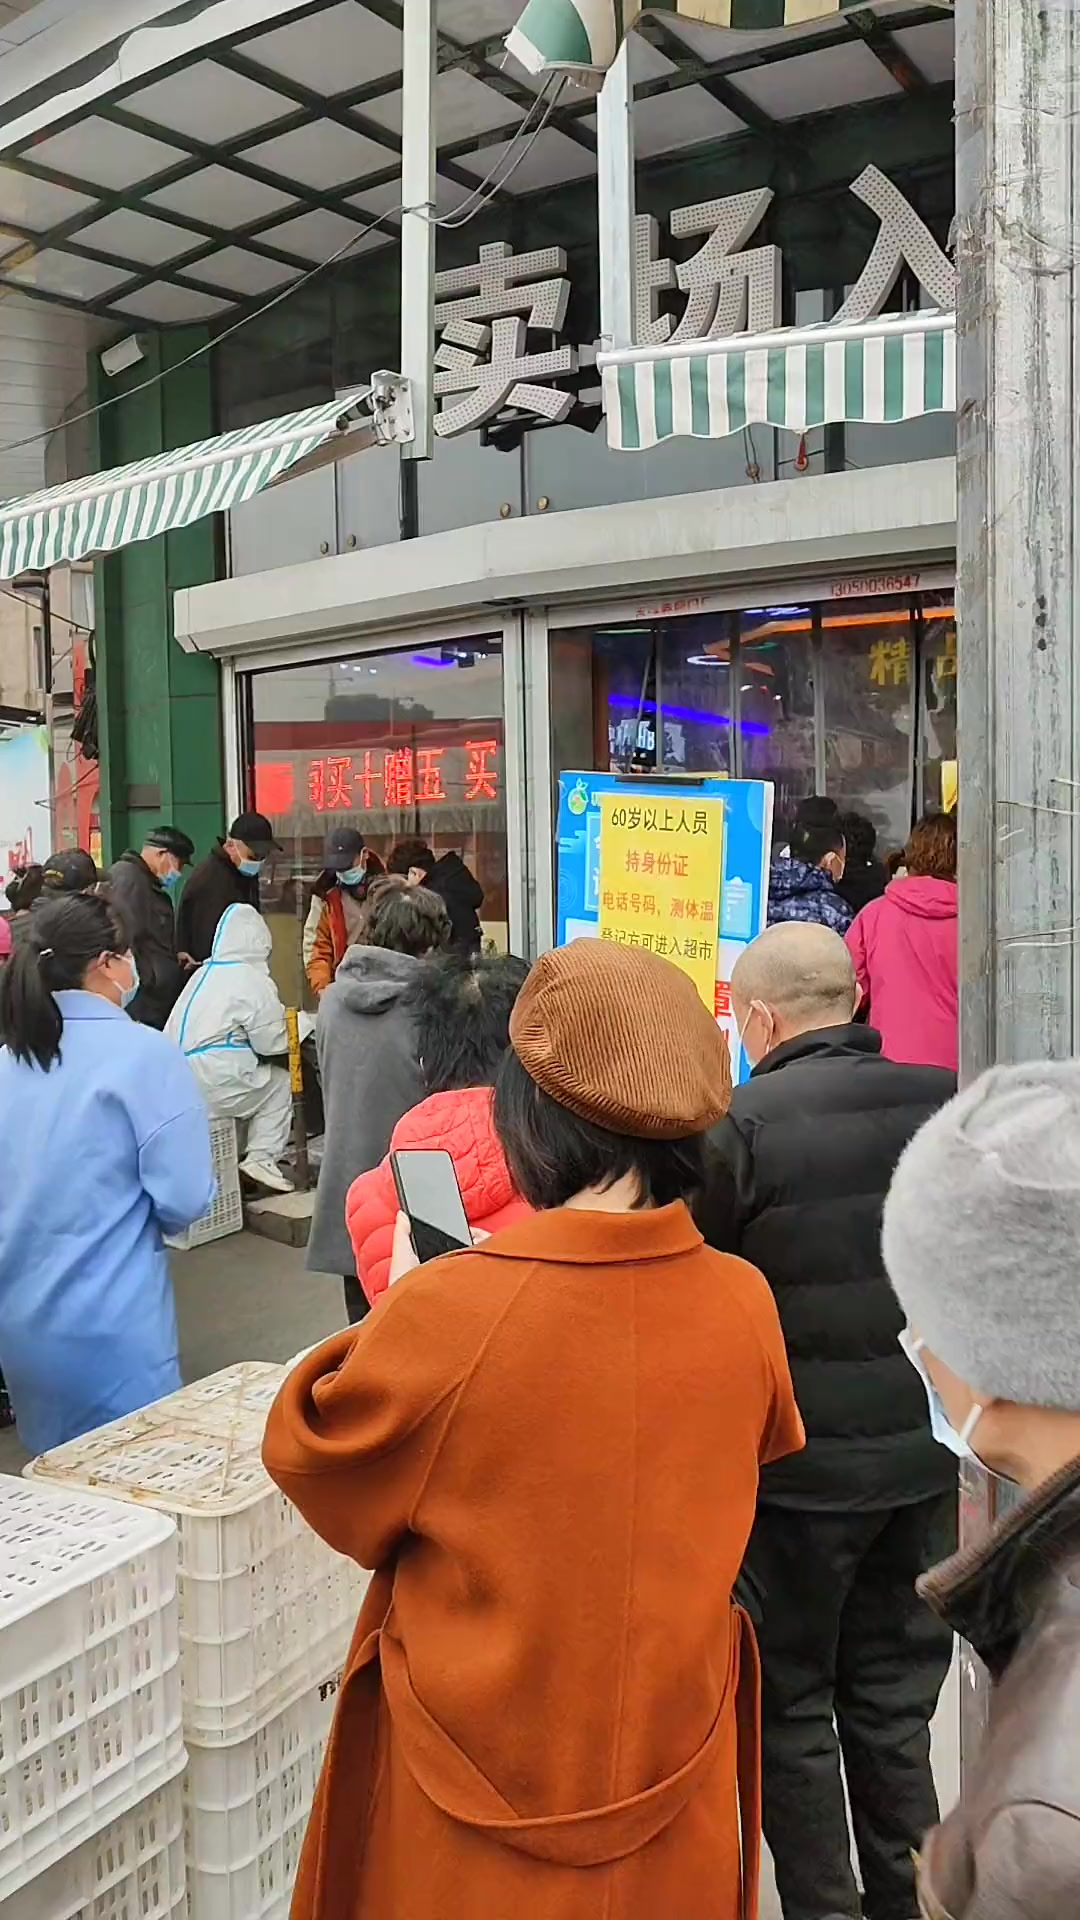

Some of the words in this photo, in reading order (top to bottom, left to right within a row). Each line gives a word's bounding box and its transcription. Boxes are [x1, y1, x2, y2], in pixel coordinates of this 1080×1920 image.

[611, 807, 708, 835] 60岁以上人员
[625, 850, 689, 877] 持身份证
